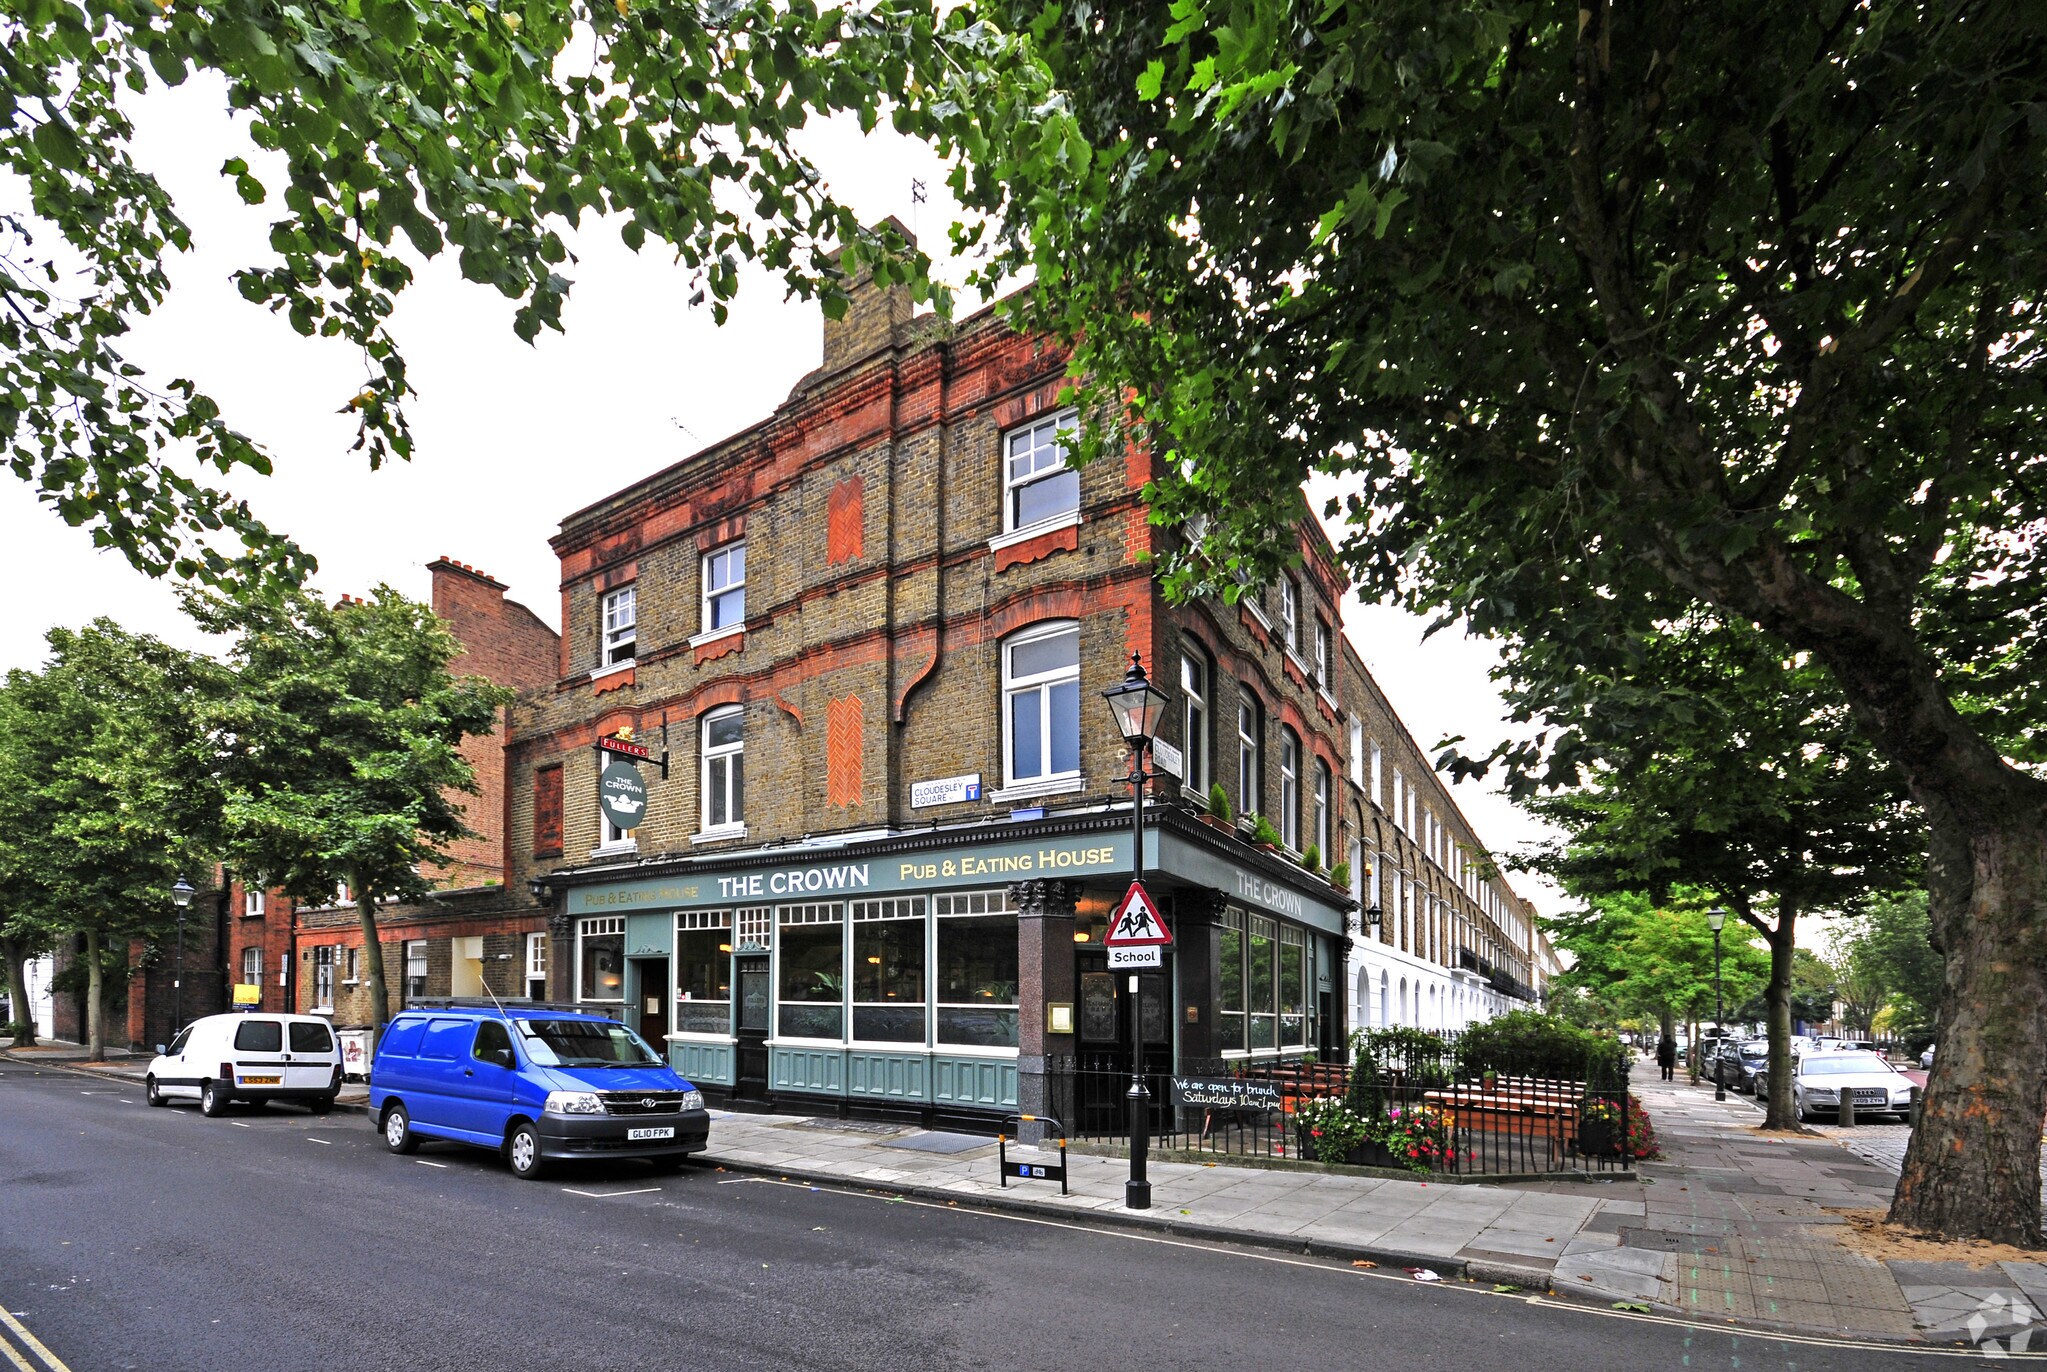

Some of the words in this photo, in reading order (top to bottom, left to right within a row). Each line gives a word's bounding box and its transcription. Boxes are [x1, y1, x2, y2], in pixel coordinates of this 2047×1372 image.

[605, 780, 642, 793] CROWN
[615, 776, 633, 786] THE
[914, 783, 963, 797] CLOUDESLEY
[914, 793, 947, 805] SQUARE
[941, 860, 957, 876] &
[718, 873, 764, 898] THE
[769, 863, 870, 894] CROWN
[608, 892, 617, 904] &
[1235, 870, 1262, 901] THE
[1263, 883, 1302, 916] CROWN
[1114, 950, 1156, 963] School
[1173, 1078, 1189, 1090] We
[1191, 1082, 1205, 1091] are
[1207, 1083, 1230, 1094] open
[1230, 1082, 1244, 1097] for
[1246, 1082, 1280, 1098] brunch
[1182, 1090, 1237, 1109] Saturdays
[633, 1129, 652, 1139] GL10
[653, 1128, 670, 1137] FPK
[1021, 1166, 1028, 1176] P
